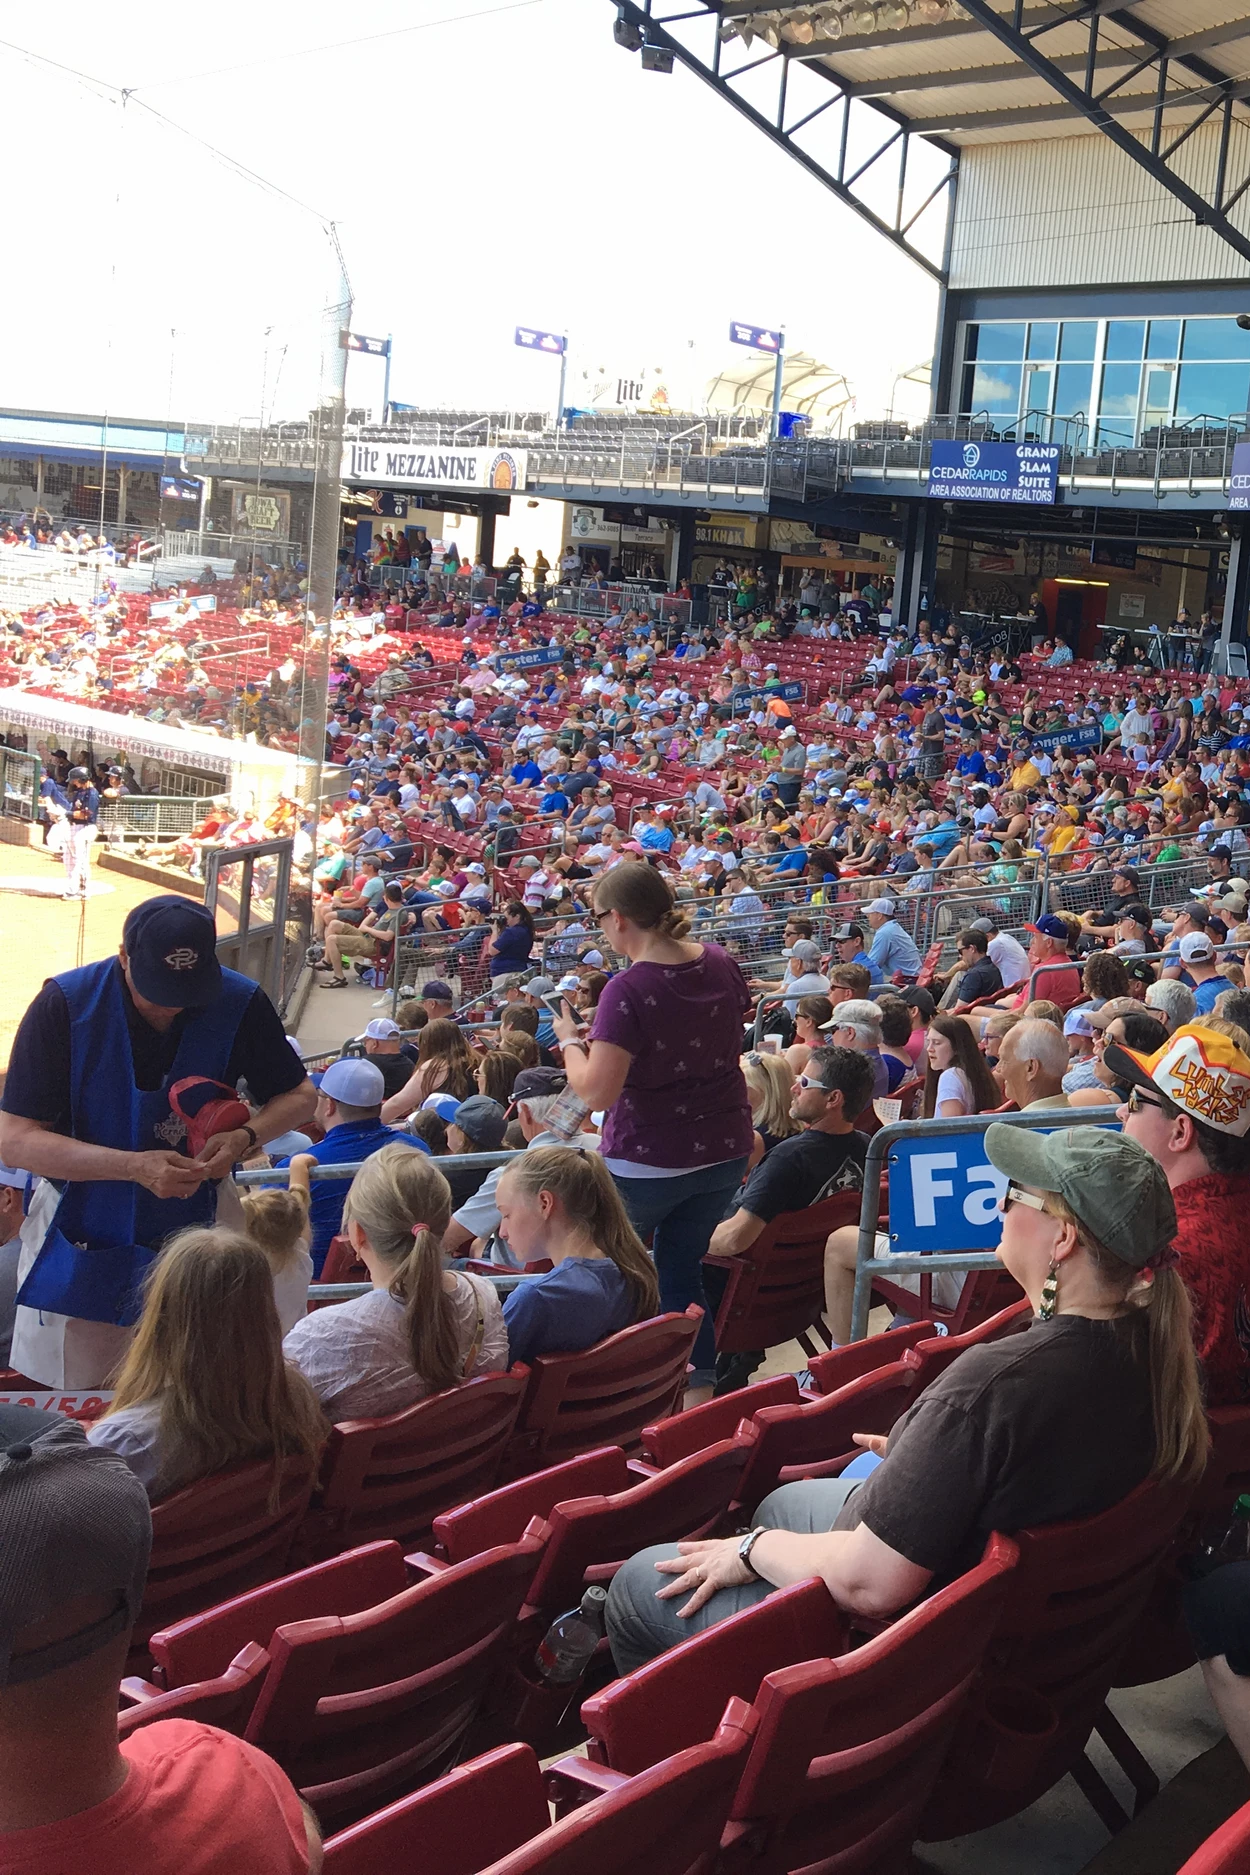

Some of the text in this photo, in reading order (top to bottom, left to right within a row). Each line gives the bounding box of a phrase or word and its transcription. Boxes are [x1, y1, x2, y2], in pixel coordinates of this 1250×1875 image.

[616, 379, 643, 404] Lite
[1016, 446, 1059, 459] GRAND
[350, 445, 477, 481] Lite MEZZANINE
[1019, 461, 1051, 473] SLAM
[1018, 476, 1050, 488] SUITE
[929, 484, 1053, 502] AREA ASSOCIATION OF REALTORS
[1229, 497, 1249, 509] AREA
[695, 527, 744, 543] 98.1 KHAK
[991, 630, 1008, 646] 108
[500, 650, 560, 668] Fster. FSB
[785, 687, 798, 696] FSB
[1079, 729, 1095, 740] FSB
[910, 1152, 1010, 1227] Fa
